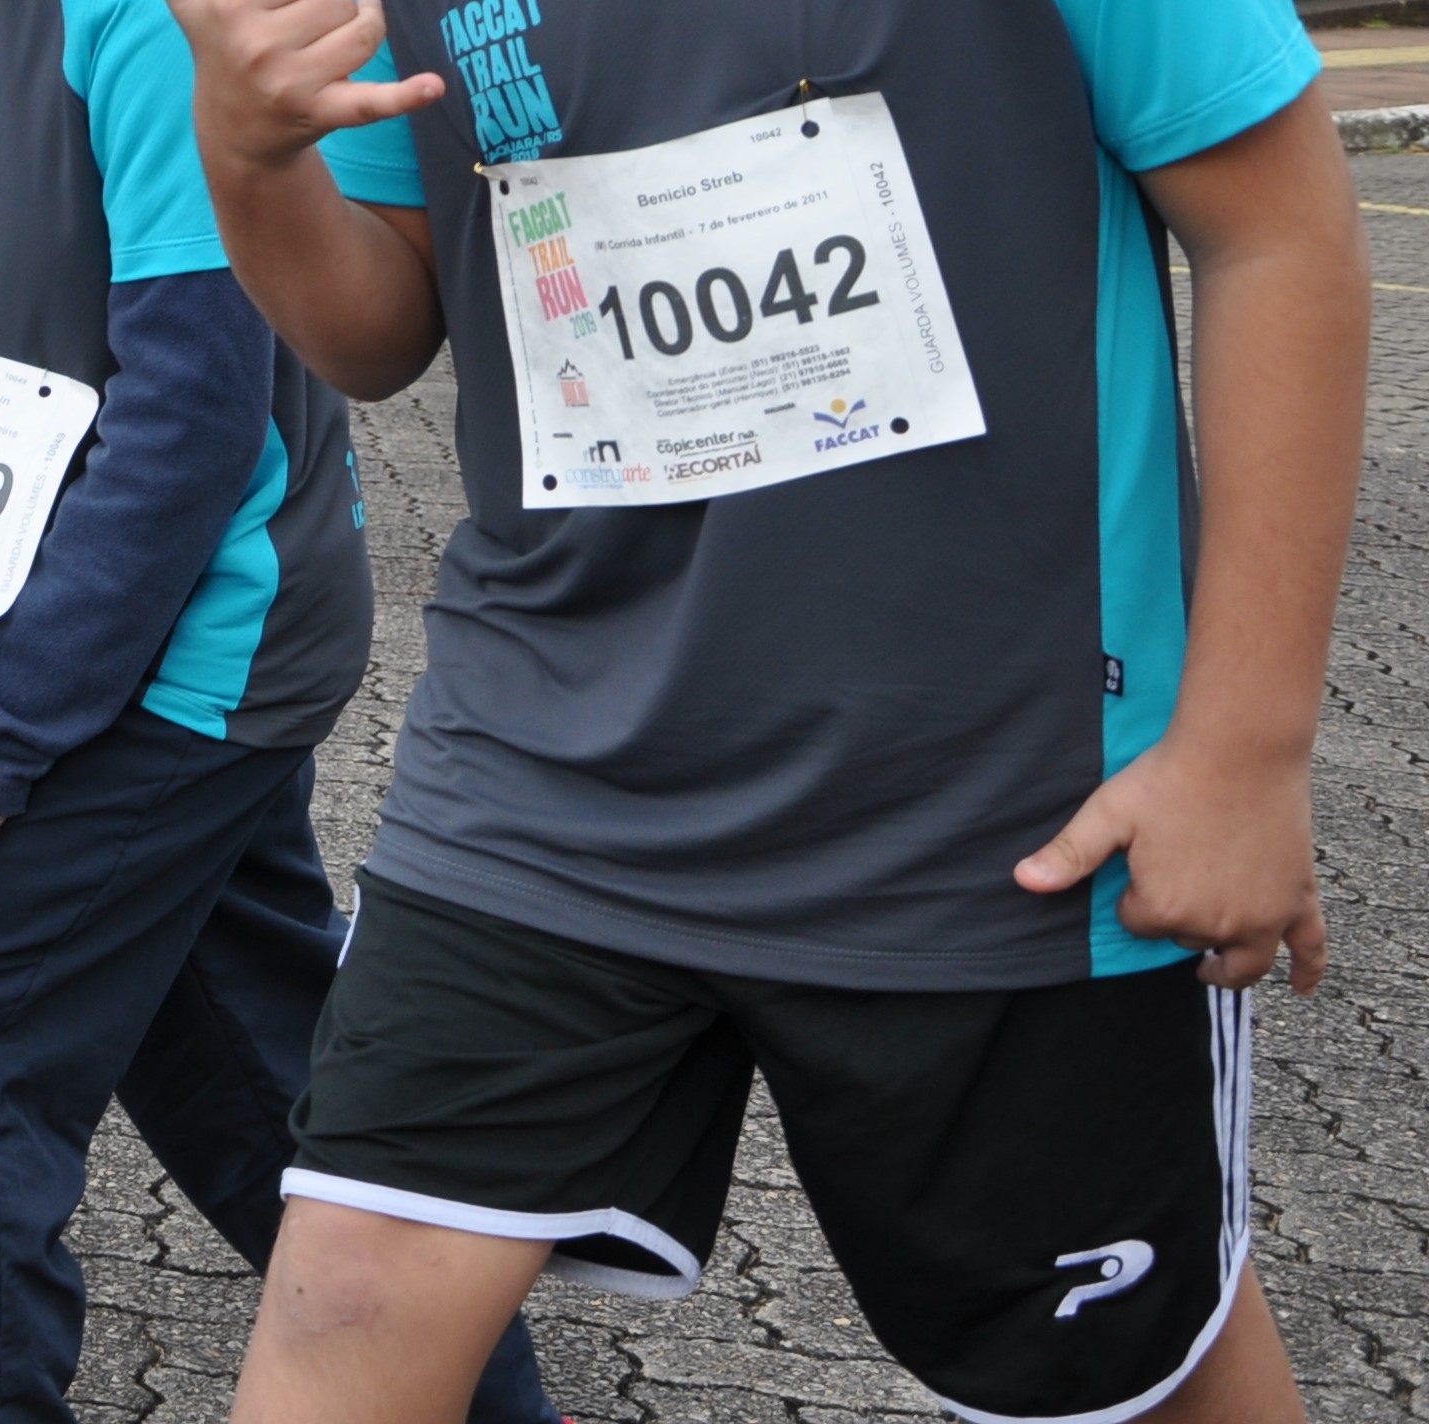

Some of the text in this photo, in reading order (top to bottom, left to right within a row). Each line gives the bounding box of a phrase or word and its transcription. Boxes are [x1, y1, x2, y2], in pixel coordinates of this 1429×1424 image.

[457, 35, 542, 96] TRAIL
[470, 74, 560, 152] RUN
[750, 127, 782, 143] 10042
[510, 148, 540, 164] 2019
[637, 170, 744, 208] Benicio Streb
[870, 161, 894, 207] 10042
[508, 191, 572, 247] FACCAT
[607, 236, 644, 251] Corrida
[645, 228, 685, 246] Infantil
[698, 223, 706, 234] 7
[709, 220, 724, 231] de
[727, 205, 781, 226] fevereiro
[784, 200, 799, 211] de
[802, 190, 829, 206] 2011
[527, 235, 575, 276] TRAIL
[889, 221, 924, 303] VOLUMES
[535, 266, 589, 322] RUN
[598, 234, 881, 361] 10042
[569, 311, 598, 339] 2019
[916, 303, 945, 374] GUARDA
[656, 431, 735, 457] copicenter
[814, 425, 880, 452] FACCAT
[565, 463, 652, 484] construarte
[0, 537, 25, 594] GUARDA
[17, 472, 48, 537] VOLUMES
[44, 432, 67, 463] 10049
